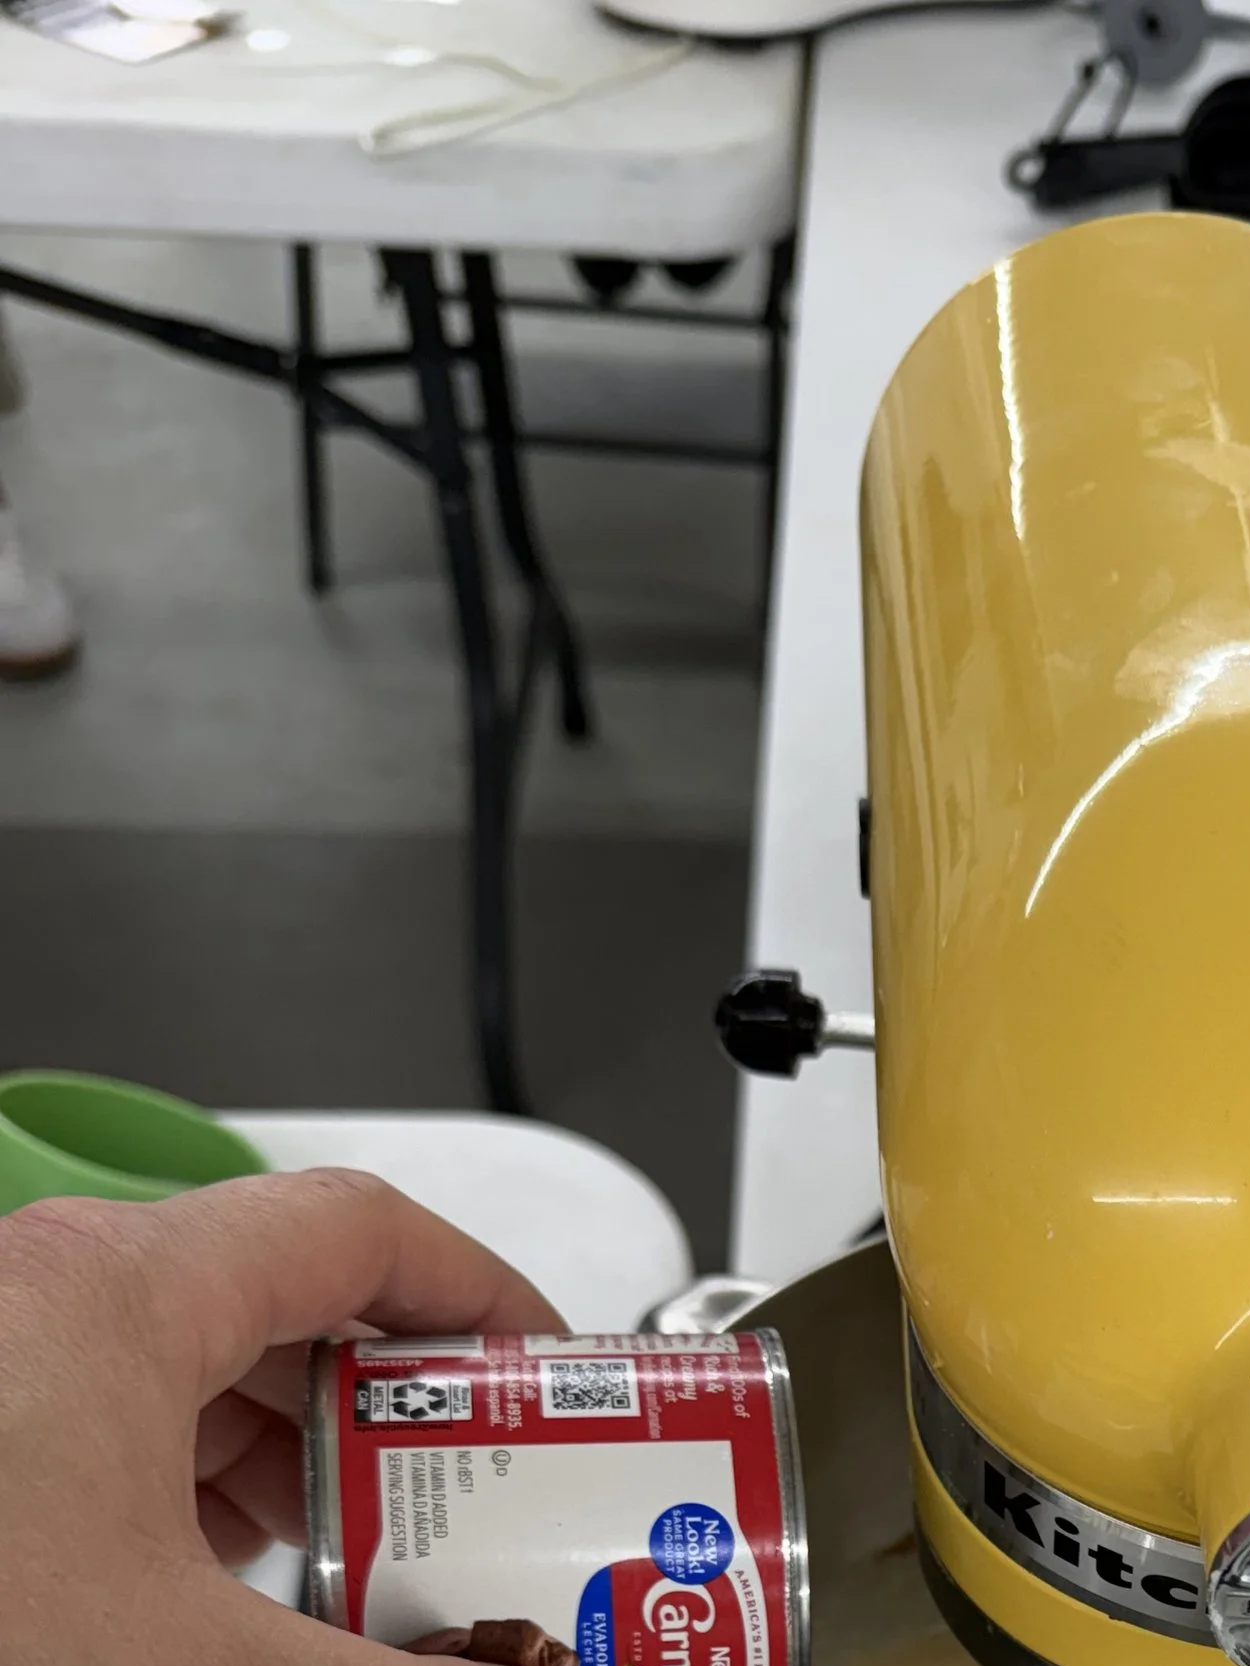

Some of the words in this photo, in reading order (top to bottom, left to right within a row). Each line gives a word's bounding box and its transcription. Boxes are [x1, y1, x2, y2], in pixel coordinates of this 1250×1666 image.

[665, 1389, 678, 1404] at
[678, 1355, 697, 1401] Creamy
[706, 1383, 725, 1394] &
[357, 1391, 370, 1411] CAN
[373, 1386, 384, 1415] METAL
[734, 1404, 750, 1418] of
[387, 1453, 404, 1495] SERVING
[411, 1452, 428, 1501] VITAMINA
[430, 1452, 446, 1492] VITAMIN
[456, 1451, 472, 1465] NO
[413, 1501, 428, 1510] D
[431, 1493, 446, 1501] D
[390, 1496, 408, 1561] SUGGESTION
[413, 1510, 431, 1560] AÑADIDA
[432, 1502, 448, 1539] ADDED
[673, 1509, 684, 1541] SAME
[984, 1460, 1200, 1611] Kitc
[663, 1519, 675, 1572] PRODUCT
[674, 1542, 685, 1579] GREAT
[685, 1516, 705, 1574] Look!
[704, 1519, 720, 1566] New
[734, 1569, 762, 1643] AMERICA'S
[582, 1622, 594, 1664] LECHE
[632, 1631, 643, 1662] ESTD
